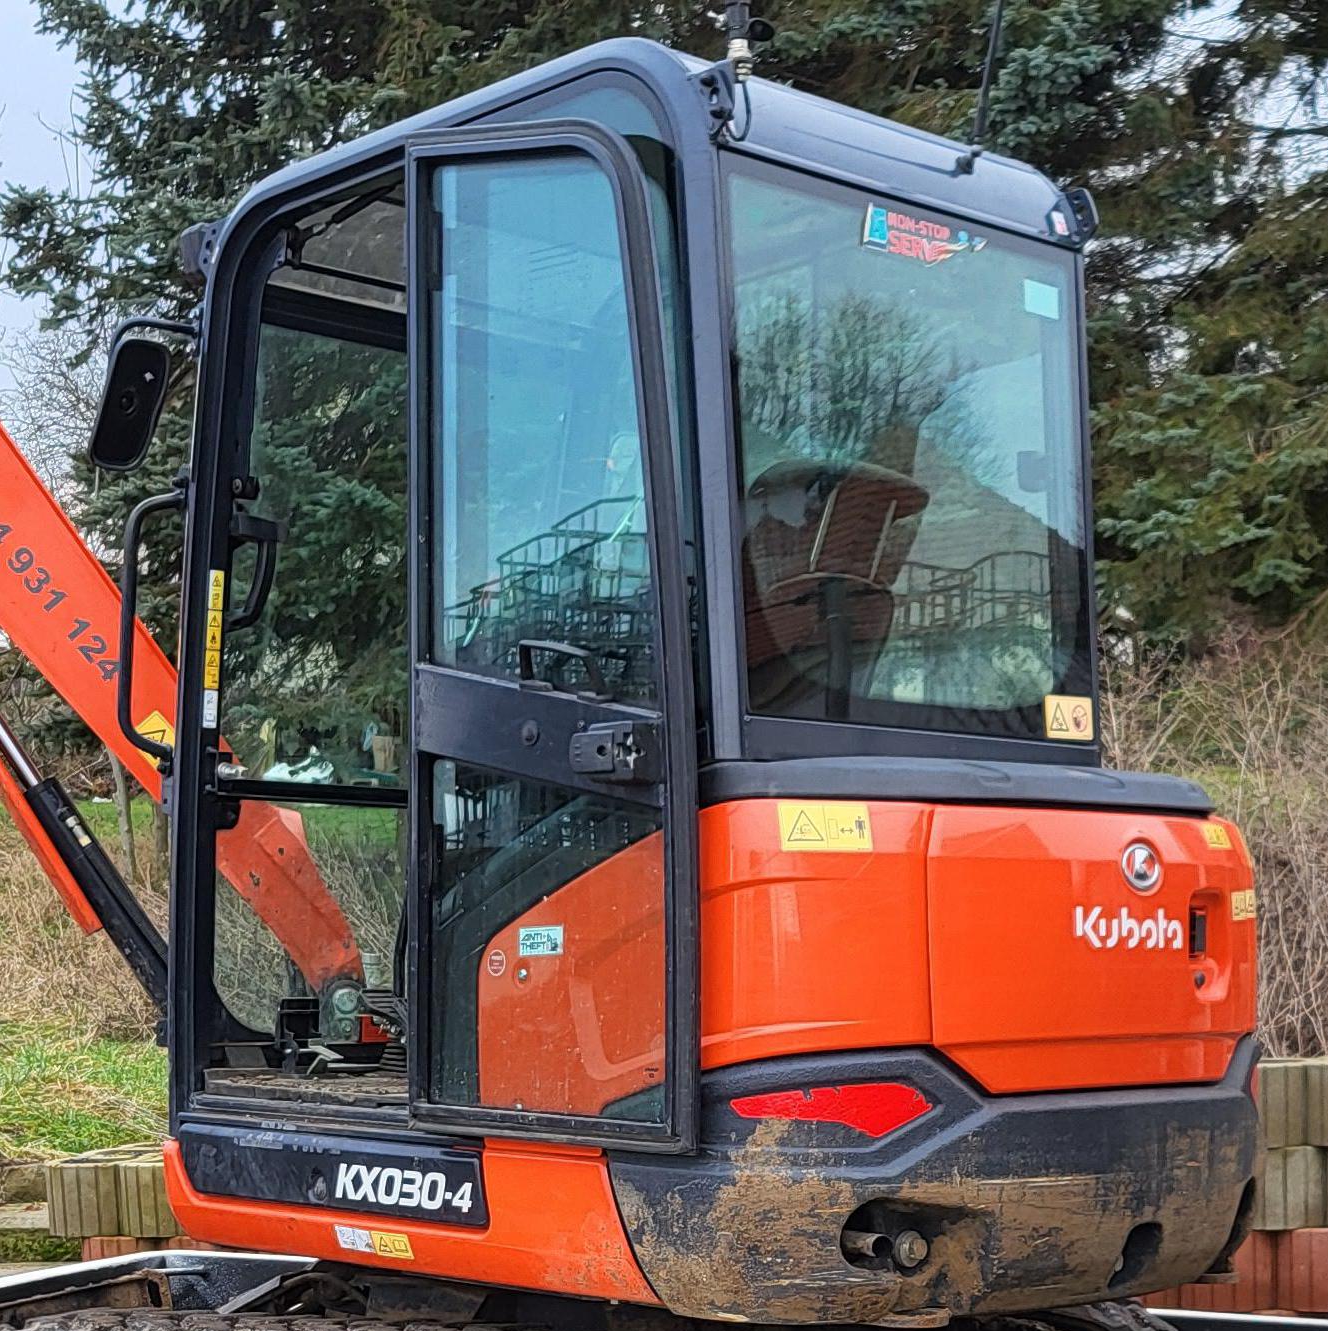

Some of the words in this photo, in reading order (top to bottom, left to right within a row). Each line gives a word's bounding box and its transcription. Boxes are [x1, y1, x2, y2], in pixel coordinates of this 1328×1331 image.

[888, 212, 951, 240] NON-STOP
[7, 547, 68, 612] 931
[67, 617, 120, 681] 124
[1075, 906, 1184, 949] Kubota
[335, 1163, 472, 1213] KX030-4
